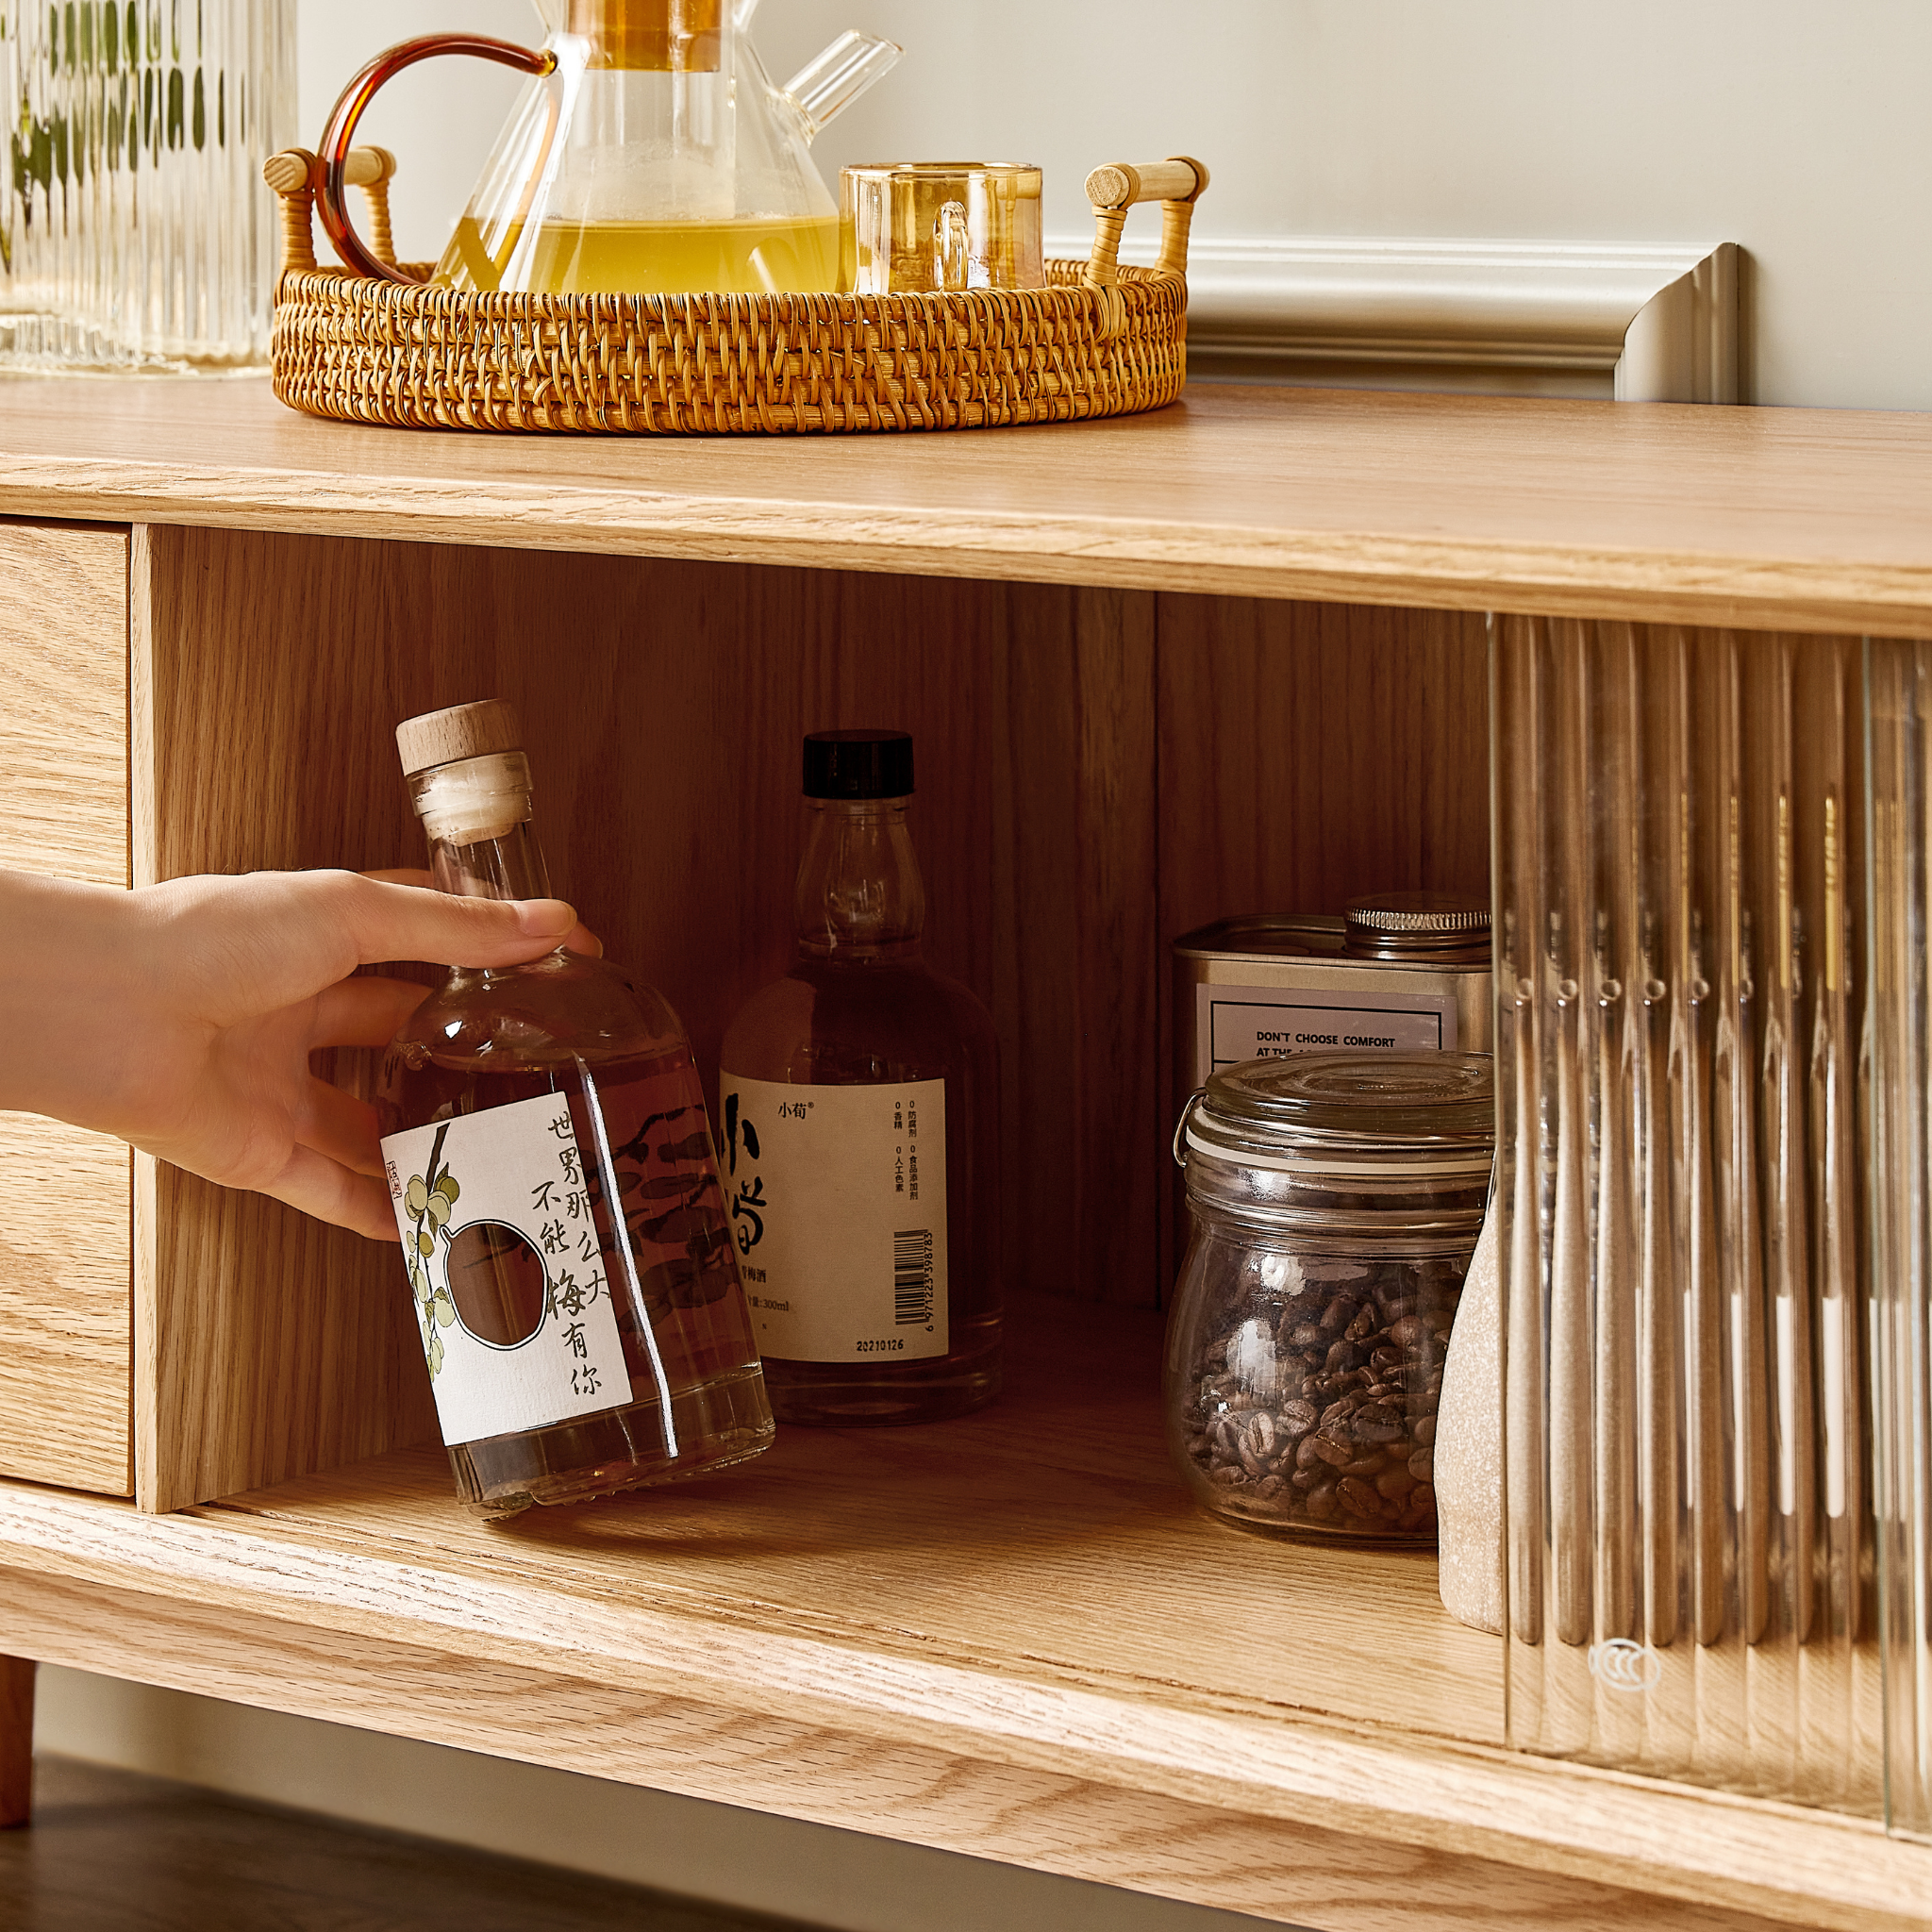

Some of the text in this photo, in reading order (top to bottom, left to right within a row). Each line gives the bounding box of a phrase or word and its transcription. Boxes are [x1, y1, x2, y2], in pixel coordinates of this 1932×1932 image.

[1257, 1031, 1395, 1047] DON'T CHOOSE COMFORT
[1257, 1047, 1270, 1057] AT
[857, 1340, 905, 1352] 20210126
